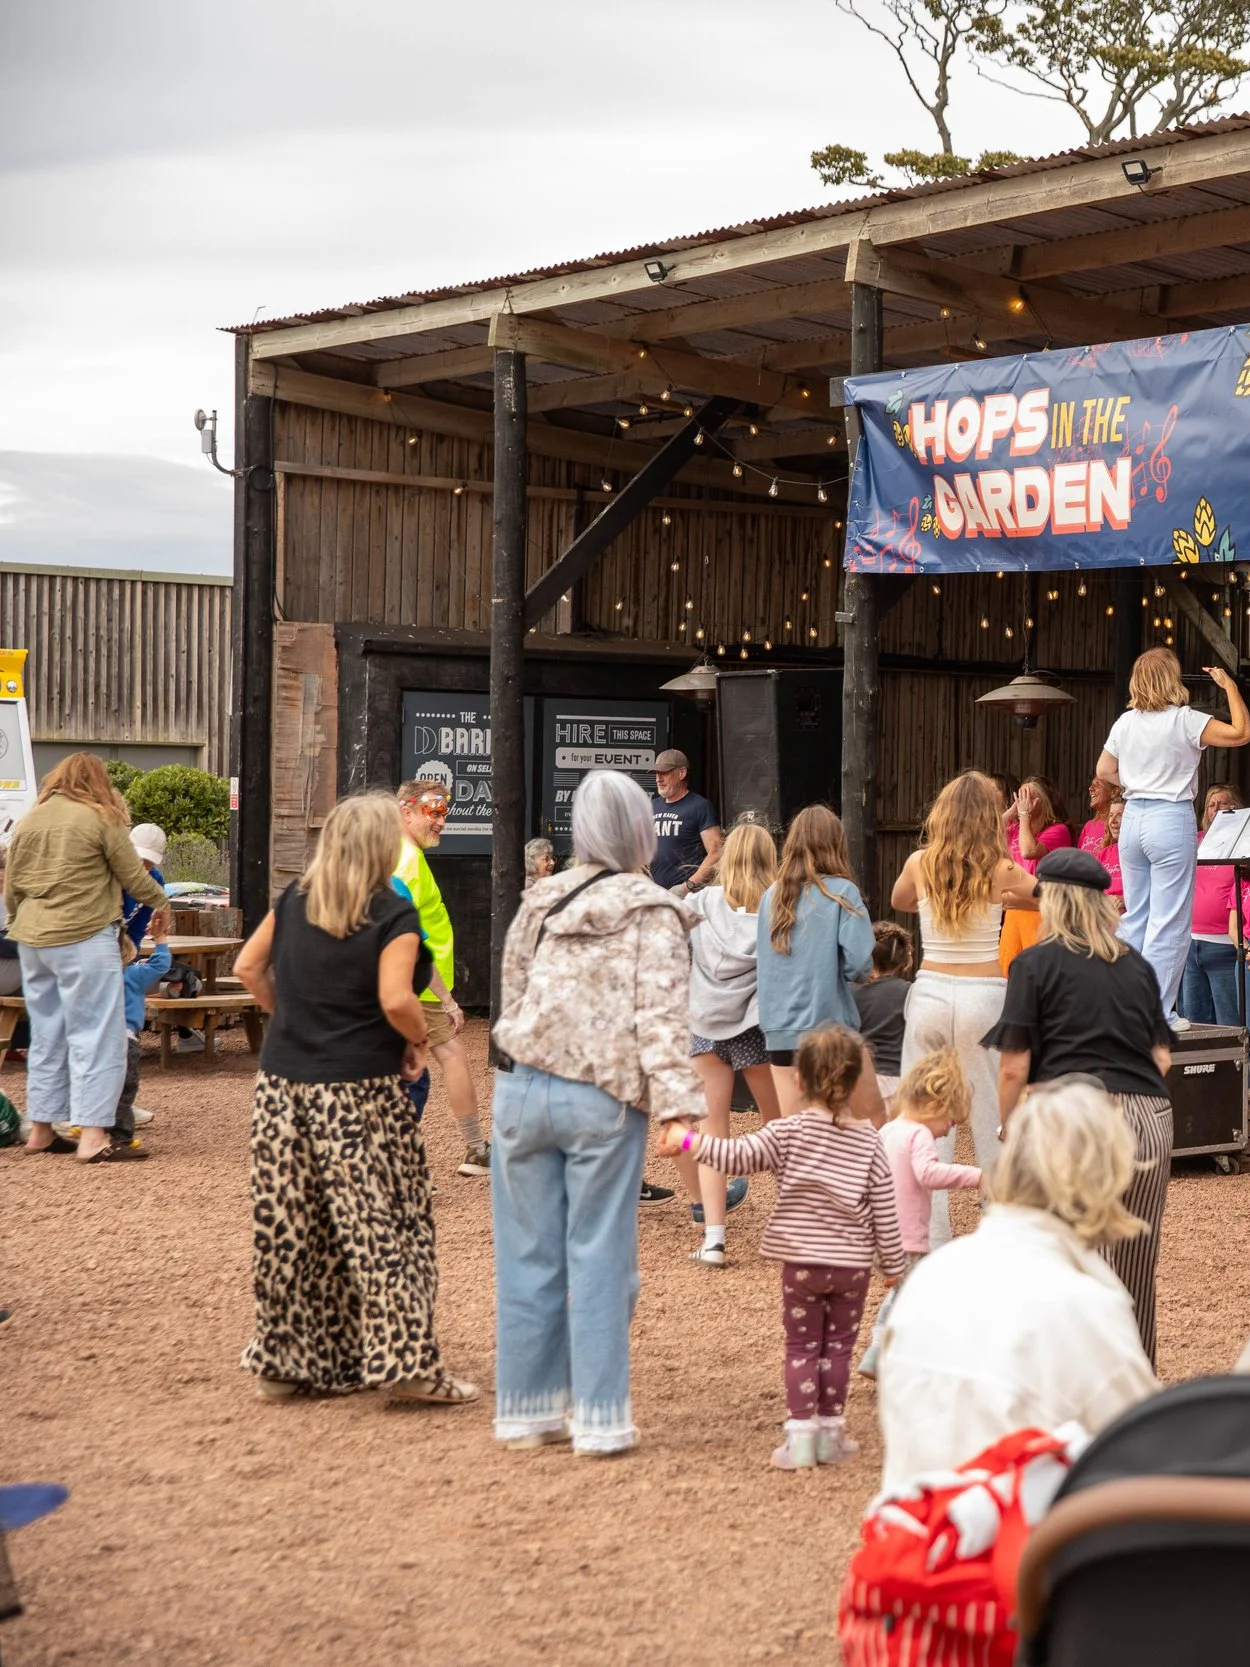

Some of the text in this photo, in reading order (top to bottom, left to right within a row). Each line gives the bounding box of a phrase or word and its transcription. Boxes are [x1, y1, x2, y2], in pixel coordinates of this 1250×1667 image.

[909, 388, 1131, 464] HOPS IN THE
[934, 456, 1132, 540] GARDEN
[459, 712, 477, 723] THE
[555, 723, 652, 744] HIRE THIS SPACE
[595, 754, 642, 765] EVENT
[477, 765, 492, 773] SEL
[456, 780, 493, 802] DA
[555, 790, 570, 802] BY
[655, 820, 683, 837] ANT
[1184, 1064, 1216, 1075] SHURE
